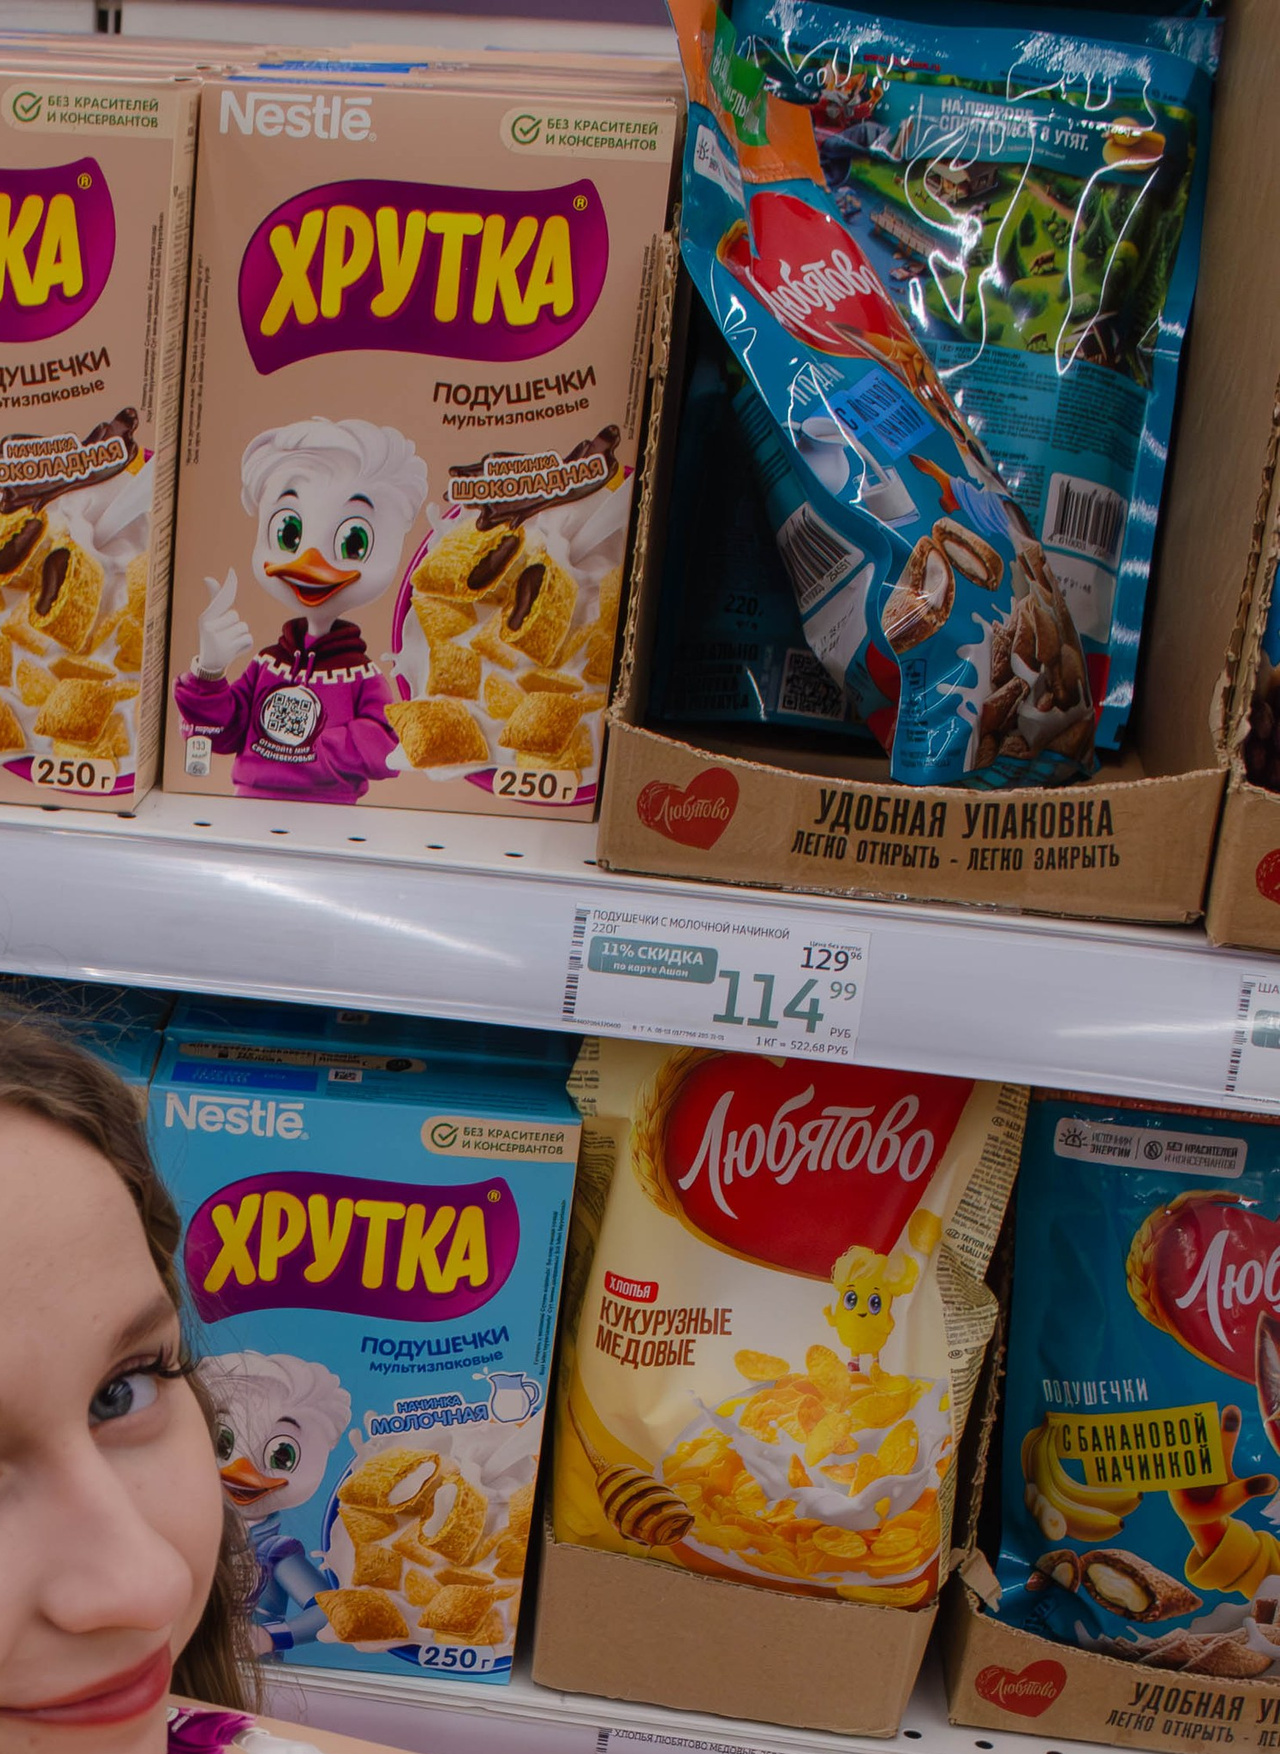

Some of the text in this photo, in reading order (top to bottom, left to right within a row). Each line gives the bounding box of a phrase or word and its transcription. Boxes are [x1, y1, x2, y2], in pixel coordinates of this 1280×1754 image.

[47, 95, 159, 113] БЕЗ КРАСИТЕЛЕЙ
[58, 112, 158, 128] КОНСЕРВАНТОВ
[547, 118, 659, 136] БЕЗ КРАСИТЕЛЕЙ
[558, 135, 657, 151] КОНСЕРВАНТОВ
[260, 205, 574, 337] ХРУТКА
[433, 366, 596, 411] ПОДУШЕЧКИ
[442, 398, 589, 428] мультизлаковые
[6, 438, 78, 459] НАЧИНКА
[488, 455, 558, 474] НАЧИНКА
[453, 458, 604, 501] ШОКОЛАДНАЯ
[38, 759, 95, 788] 250
[498, 771, 573, 799] 250 г
[659, 782, 730, 823] Любятово
[813, 788, 1114, 839] УДОБНАЯ УПАКОВКА
[791, 829, 1120, 871] ЛЕГКО ОТКРЫТЬ ЛЕГКО ЗАКРЫТЬ
[592, 924, 620, 935] 220Г
[593, 910, 790, 939] ПОДУШЕЧКИ С МОЛОЧНОЙ НАЧИНКОЙ
[601, 942, 704, 966] 11% СКИДКА
[800, 947, 849, 972] 129
[614, 962, 688, 978] по карте Ашан
[712, 970, 857, 1034] 114 99
[830, 1027, 852, 1038] РУБ
[764, 1038, 848, 1055] КГ 522,68 РУБ
[462, 1126, 565, 1143] БЕЗ КРАСИТЕЛЕЙ
[473, 1141, 564, 1155] КОНСЕРВАНТОВ
[678, 1084, 935, 1220] Любятово
[1090, 1144, 1131, 1158] ЭНЕРГИИ
[1185, 1144, 1238, 1158] КРАСИТЕЛЕЙ
[205, 1190, 490, 1295] ХРУТКА
[609, 1275, 651, 1300] ХЛОПЬЯ
[599, 1296, 733, 1337] КУКУРУЗНЫЕ
[360, 1325, 510, 1360] ПОДУШЕЧКИ
[595, 1332, 696, 1370] МЕДОВЫЕ
[369, 1348, 504, 1374] мультизлаковые
[398, 1395, 461, 1414] НАЧИНКА
[1042, 1377, 1148, 1408] ПОДУШЕЧКИ
[371, 1404, 489, 1435] МОЛОЧНАЯ
[1063, 1412, 1209, 1452] С БАНАНОВОЙ
[1096, 1444, 1213, 1484] НАЧИНКОЙ
[424, 1647, 491, 1670] 250 г
[992, 1676, 1057, 1700] Любятово
[1128, 1681, 1245, 1723] УДОБНАЯ
[614, 1729, 653, 1743] ХЛОПЬЯ
[654, 1735, 707, 1751] ЛЮБЯТОВО
[1105, 1709, 1235, 1744] ЛЕГКО ОТКРЫТЬ
